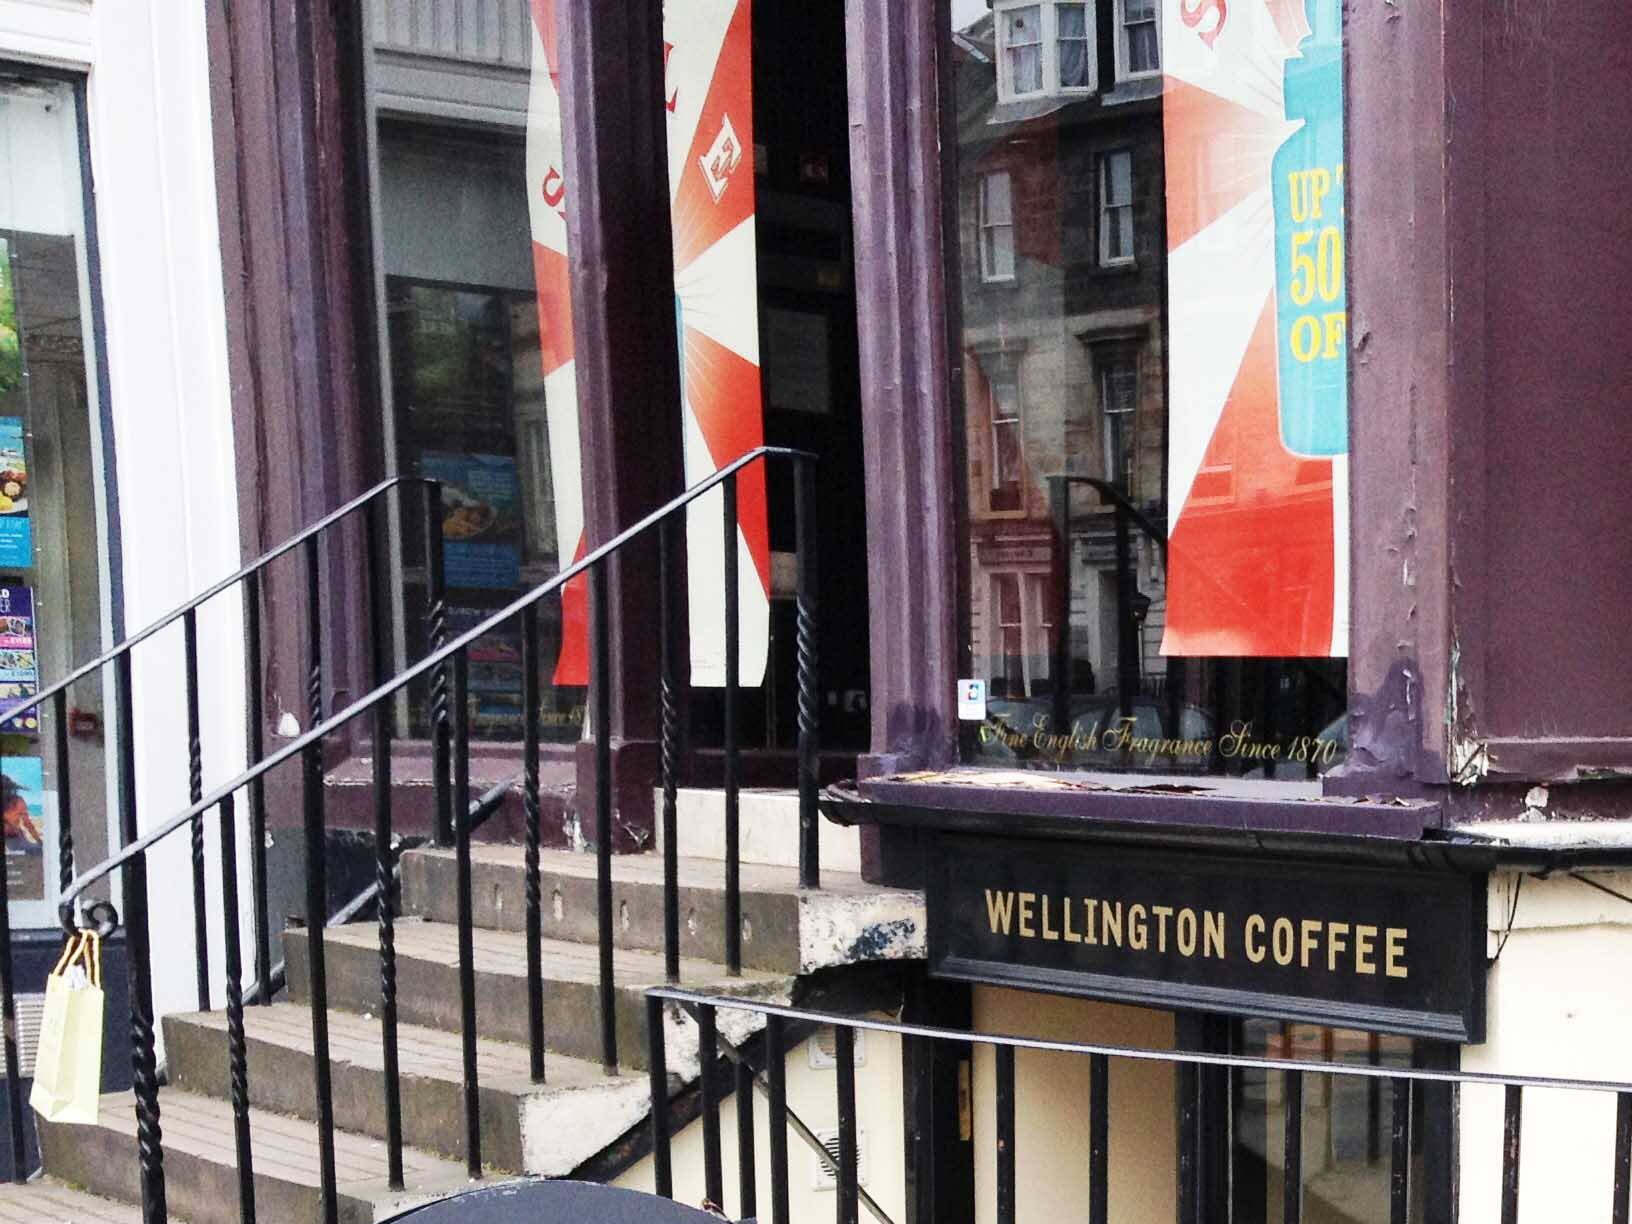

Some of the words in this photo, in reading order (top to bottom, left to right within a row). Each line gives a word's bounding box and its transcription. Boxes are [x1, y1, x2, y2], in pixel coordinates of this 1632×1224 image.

[1288, 168, 1331, 223] UP
[978, 712, 1026, 750] Fine
[1032, 712, 1097, 759] English
[1103, 716, 1212, 766] Fragrance
[1218, 719, 1281, 761] Since
[1287, 735, 1337, 765] 1870
[985, 889, 1226, 960] WELLINGTON
[1244, 914, 1408, 978] COFFEE
